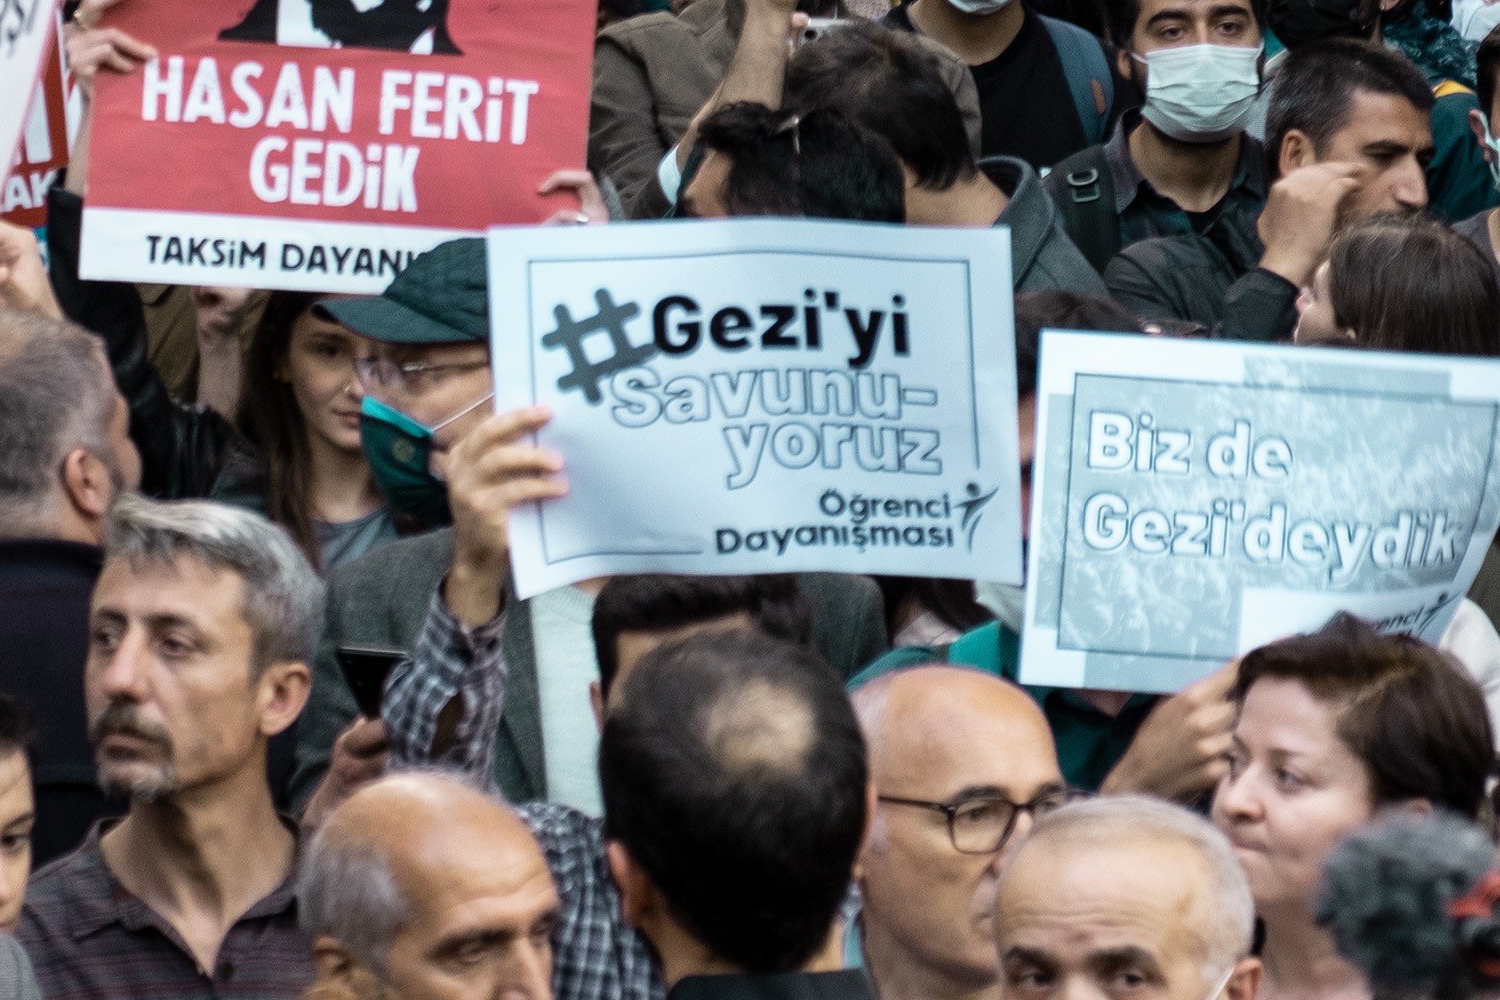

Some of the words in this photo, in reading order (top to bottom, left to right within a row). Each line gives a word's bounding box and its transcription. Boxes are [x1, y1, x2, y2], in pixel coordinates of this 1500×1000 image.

[141, 54, 355, 134] HASAN
[610, 365, 939, 429] Savunu-
[723, 420, 943, 491] yoruz
[1086, 409, 1192, 475] Biz
[1206, 418, 1294, 480] de
[714, 520, 954, 557] Dayanışması
[819, 488, 952, 523] Öğrenci
[1081, 493, 1459, 587] Gezi'deydik
